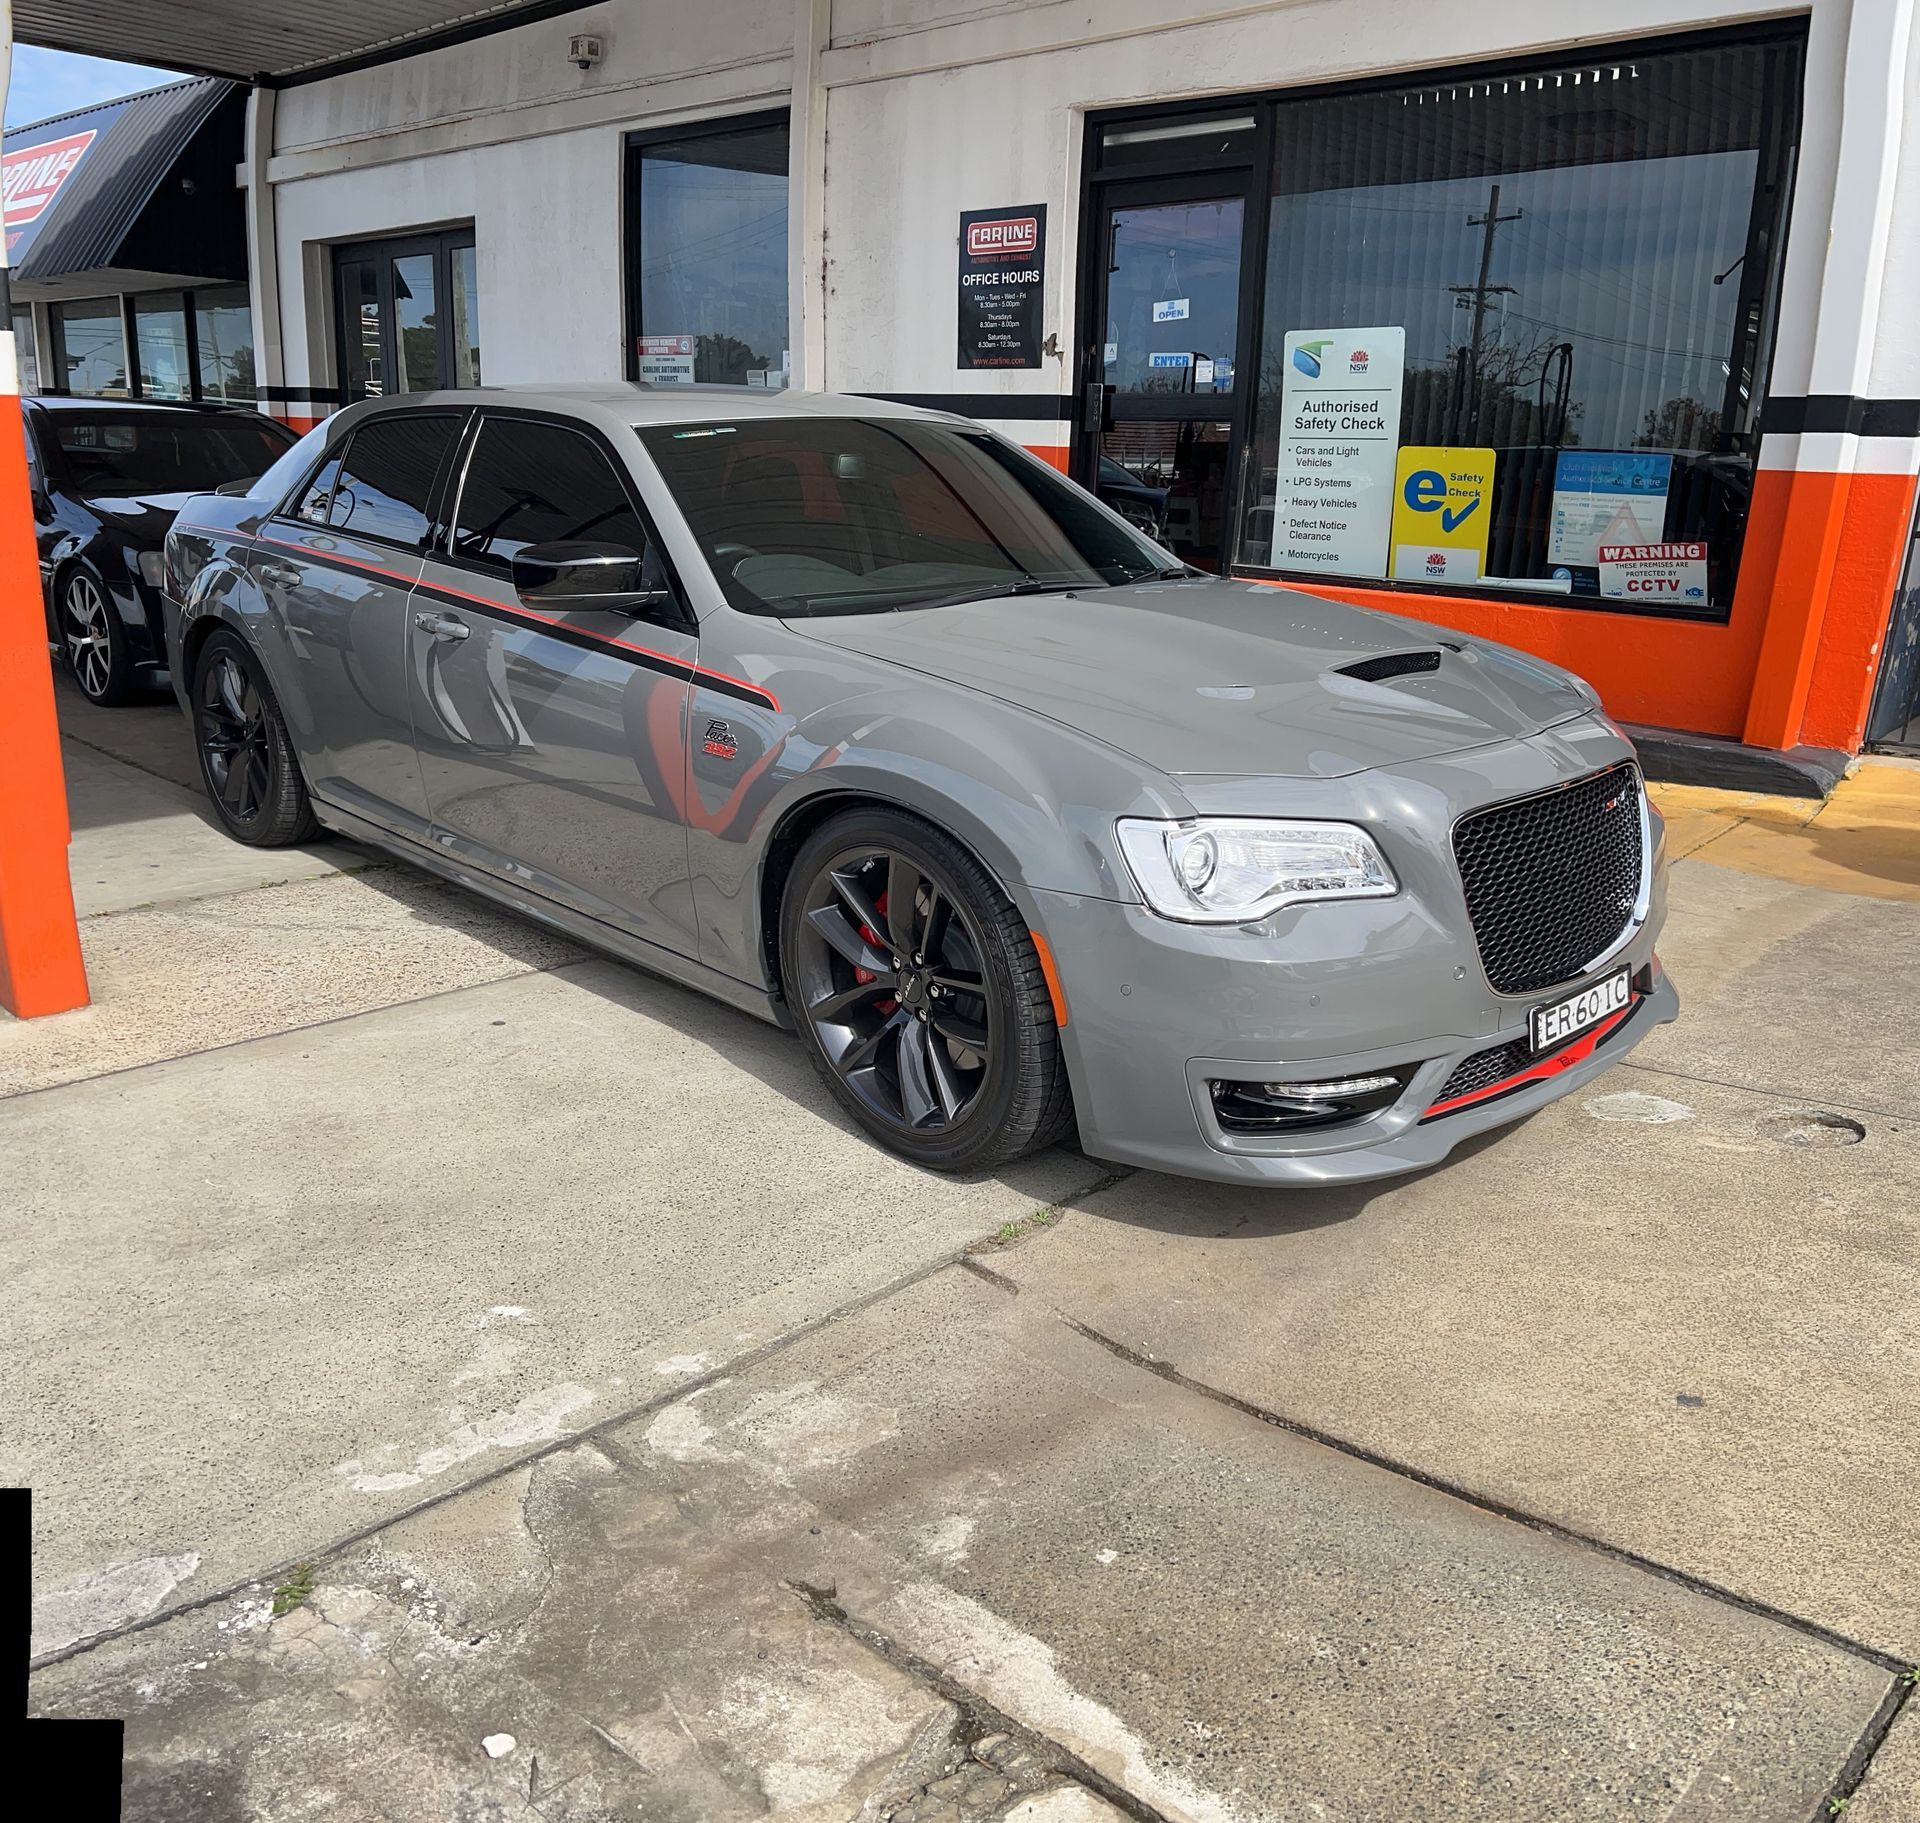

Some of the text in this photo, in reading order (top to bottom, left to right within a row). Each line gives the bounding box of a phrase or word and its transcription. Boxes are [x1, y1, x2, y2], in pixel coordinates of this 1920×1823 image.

[3, 147, 81, 213] RLINE
[971, 224, 1033, 249] CARLINE
[962, 270, 1040, 286] OFFICE HOURS
[1001, 300, 1020, 308] 5.00pm
[987, 313, 1012, 321] Thursdays
[1158, 309, 1184, 320] OPEN
[987, 333, 1012, 341] Saturdays
[1153, 355, 1189, 367] ENTER
[1349, 363, 1369, 371] NSW
[1302, 400, 1378, 412] Authorised
[1294, 417, 1385, 432] Safety Check
[1295, 445, 1360, 458] Cars and Light
[1296, 458, 1333, 467] Vehicles
[1293, 477, 1352, 489] LPG Systems
[1449, 472, 1485, 484] Safety
[1633, 476, 1661, 487] Centre
[1404, 469, 1447, 513] e
[1448, 487, 1481, 498] Check
[1291, 497, 1358, 509] Heavy Vehicles
[1290, 518, 1348, 530] Defect Notice
[1289, 530, 1332, 541] Clearance
[1287, 549, 1340, 562] Motorcycles
[1603, 545, 1700, 561] WARNING
[1425, 566, 1446, 574] NSW
[1615, 562, 1637, 570] THESE
[1639, 561, 1674, 569] PREMISES
[1625, 570, 1666, 578] PROTECTED
[1626, 579, 1681, 592] CCTV
